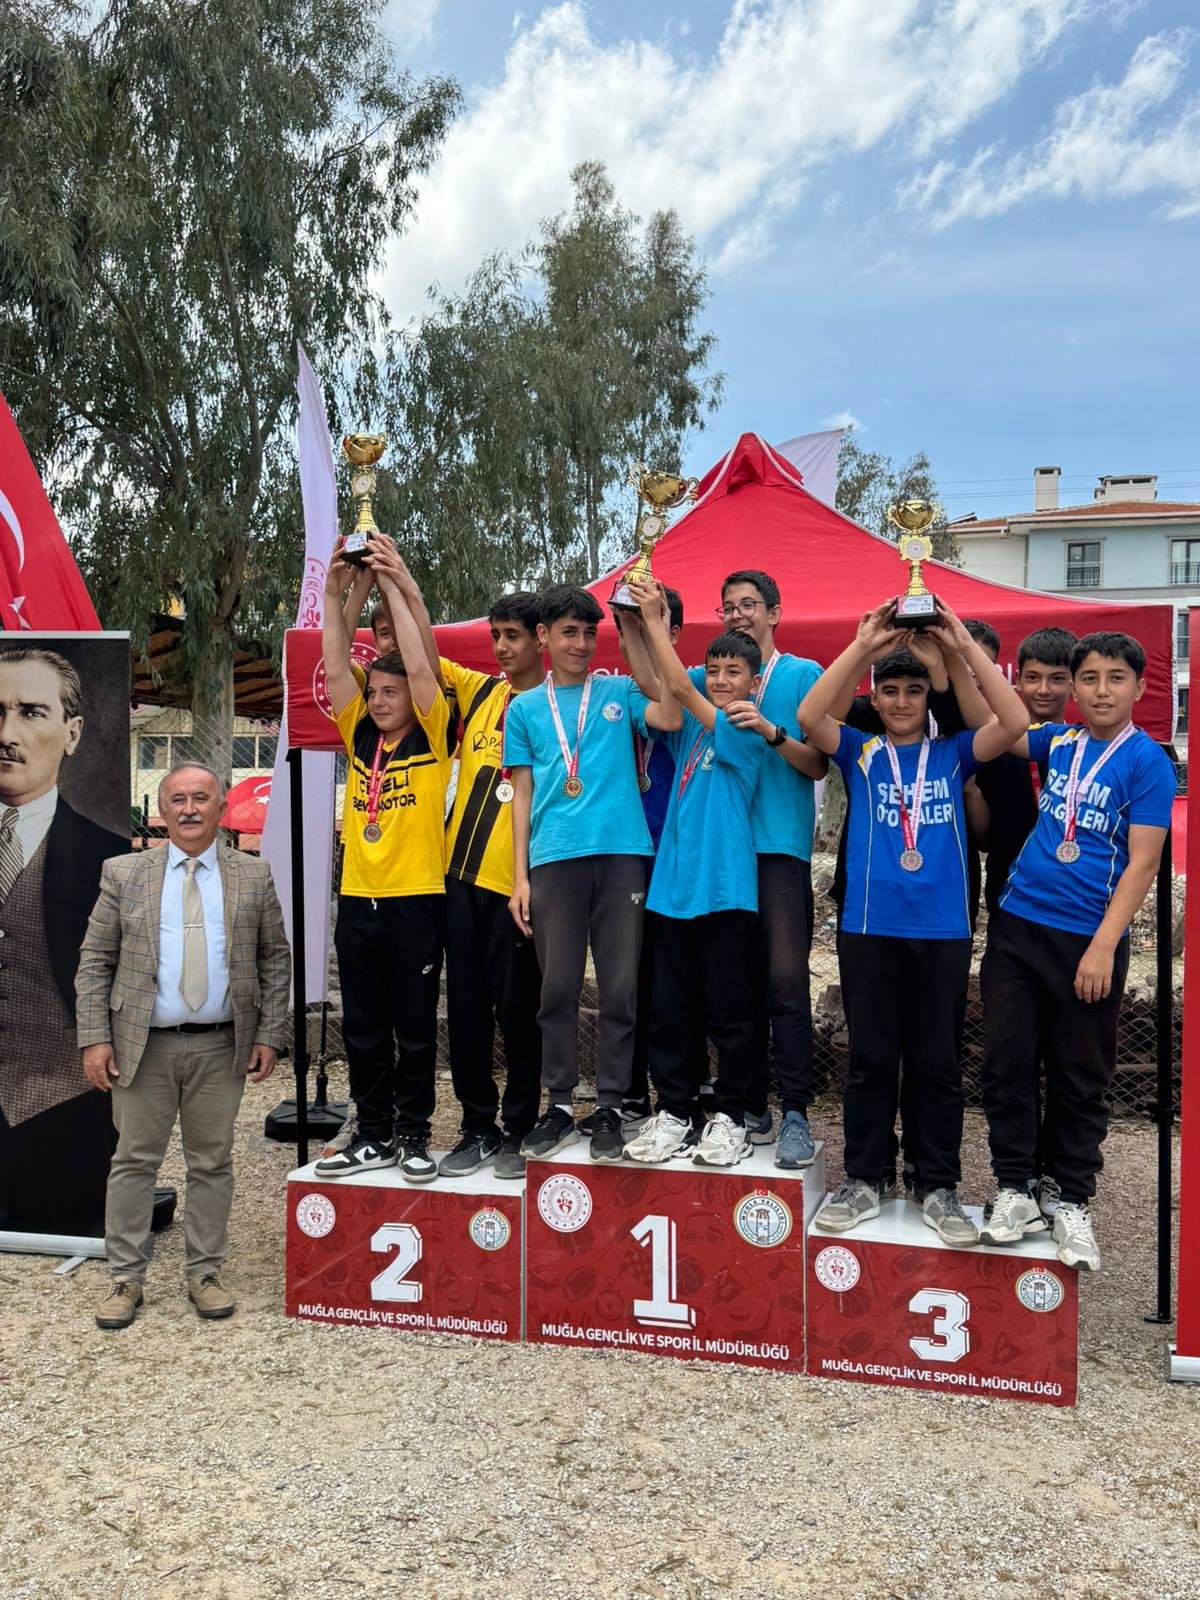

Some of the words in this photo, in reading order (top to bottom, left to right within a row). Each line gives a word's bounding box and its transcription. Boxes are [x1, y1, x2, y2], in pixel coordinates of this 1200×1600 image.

[877, 776, 950, 805] SEHEM
[1047, 768, 1112, 809] SEM
[876, 803, 899, 827] OO
[1054, 802, 1110, 833] GLERİ
[370, 1222, 423, 1303] 2
[630, 1214, 696, 1330] 1
[298, 1304, 335, 1317] MUĞLA
[336, 1307, 380, 1323] GENÇLİK
[380, 1312, 395, 1323] VE
[396, 1313, 426, 1326] SPOR
[426, 1313, 436, 1328] İL
[437, 1315, 508, 1335] MÜDÜRLÜĞÜ
[908, 1287, 971, 1363] 3
[542, 1323, 585, 1340] MUĞLA
[586, 1328, 639, 1346] GENÇLİK
[639, 1333, 655, 1346] VE
[656, 1335, 691, 1350] SPOR
[692, 1336, 704, 1352] İL
[705, 1338, 790, 1360] MÜDÜRLÜĞÜ
[822, 1358, 863, 1373] MUĞLA
[865, 1363, 915, 1380] GENÇLİK
[916, 1369, 932, 1381] VE
[933, 1371, 967, 1386] SPOR
[968, 1372, 980, 1388] İL
[981, 1375, 1062, 1396] MÜDÜRLÜĞÜ
